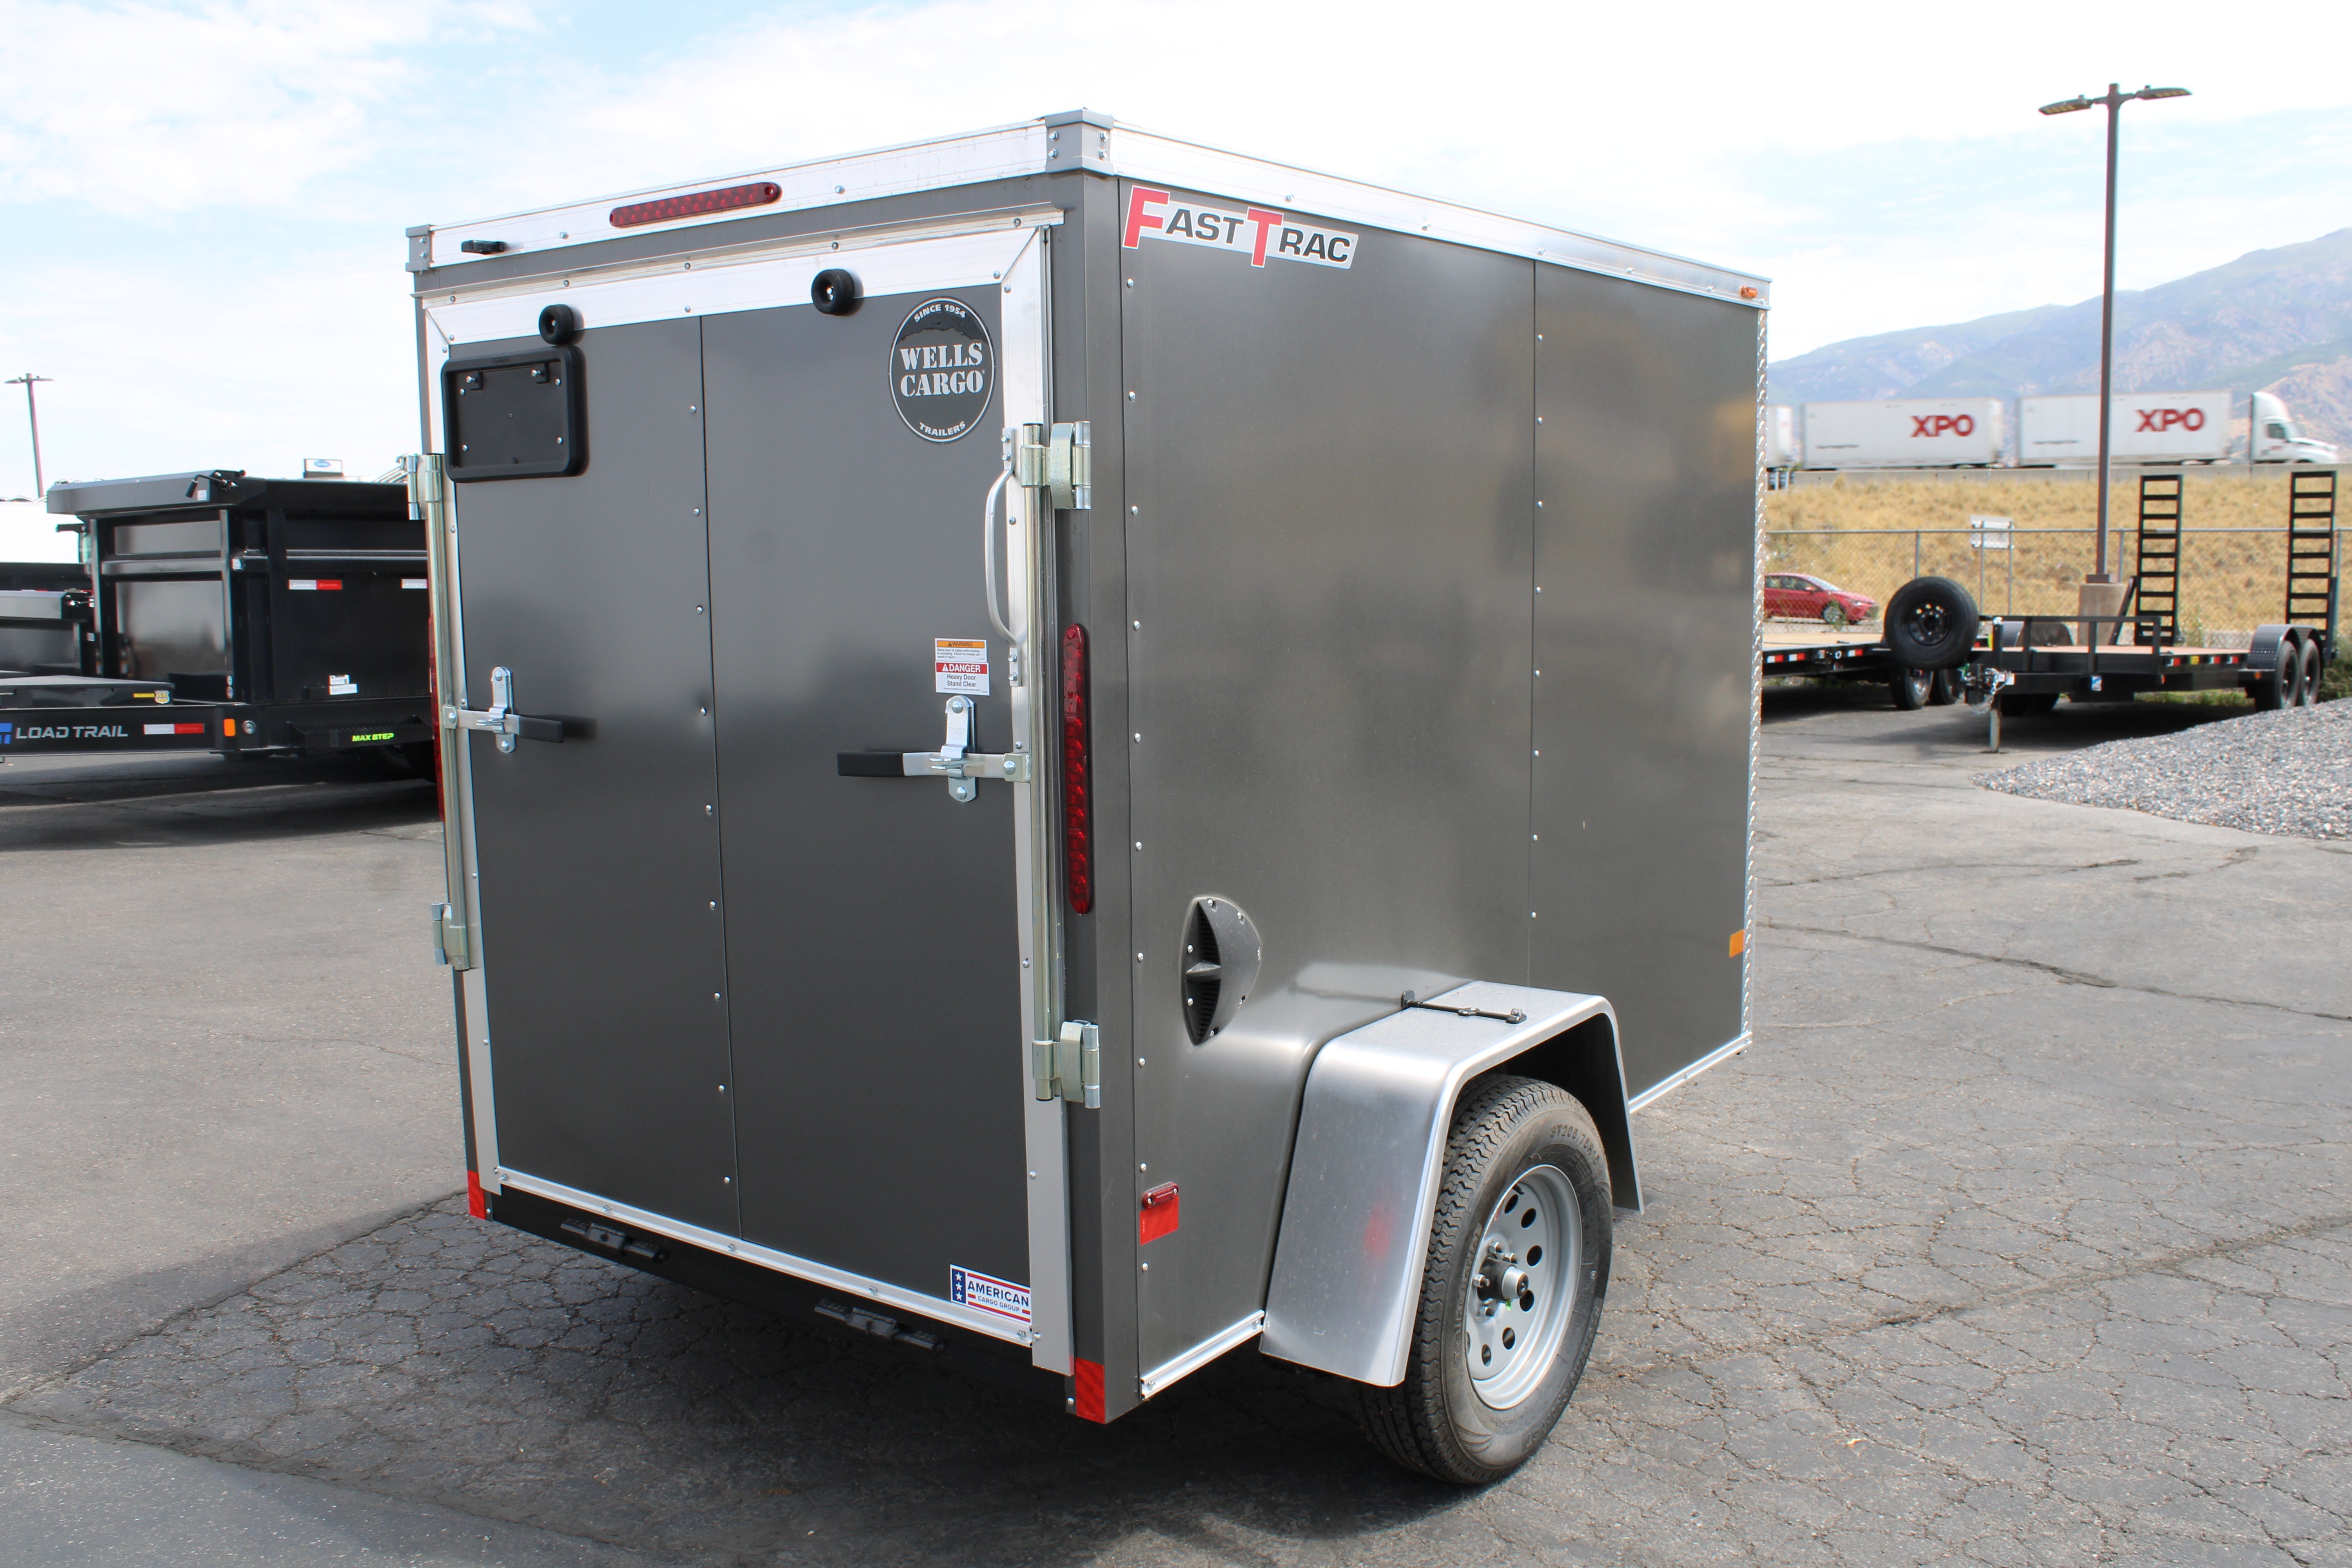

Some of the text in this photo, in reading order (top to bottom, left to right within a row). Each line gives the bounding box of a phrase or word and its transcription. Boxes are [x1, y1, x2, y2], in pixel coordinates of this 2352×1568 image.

[914, 304, 966, 322] SINCE 1954
[900, 343, 983, 370] WELLS
[900, 370, 983, 397] CARGO
[920, 421, 966, 436] TRAILERS
[1910, 414, 1975, 437] XPO
[2136, 408, 2205, 433] XPO
[949, 664, 981, 673] DANGER
[16, 726, 129, 739] LOAD TRAIL
[967, 1281, 1029, 1307] AMERICAN
[978, 1295, 1020, 1312] CARGO GROUP
